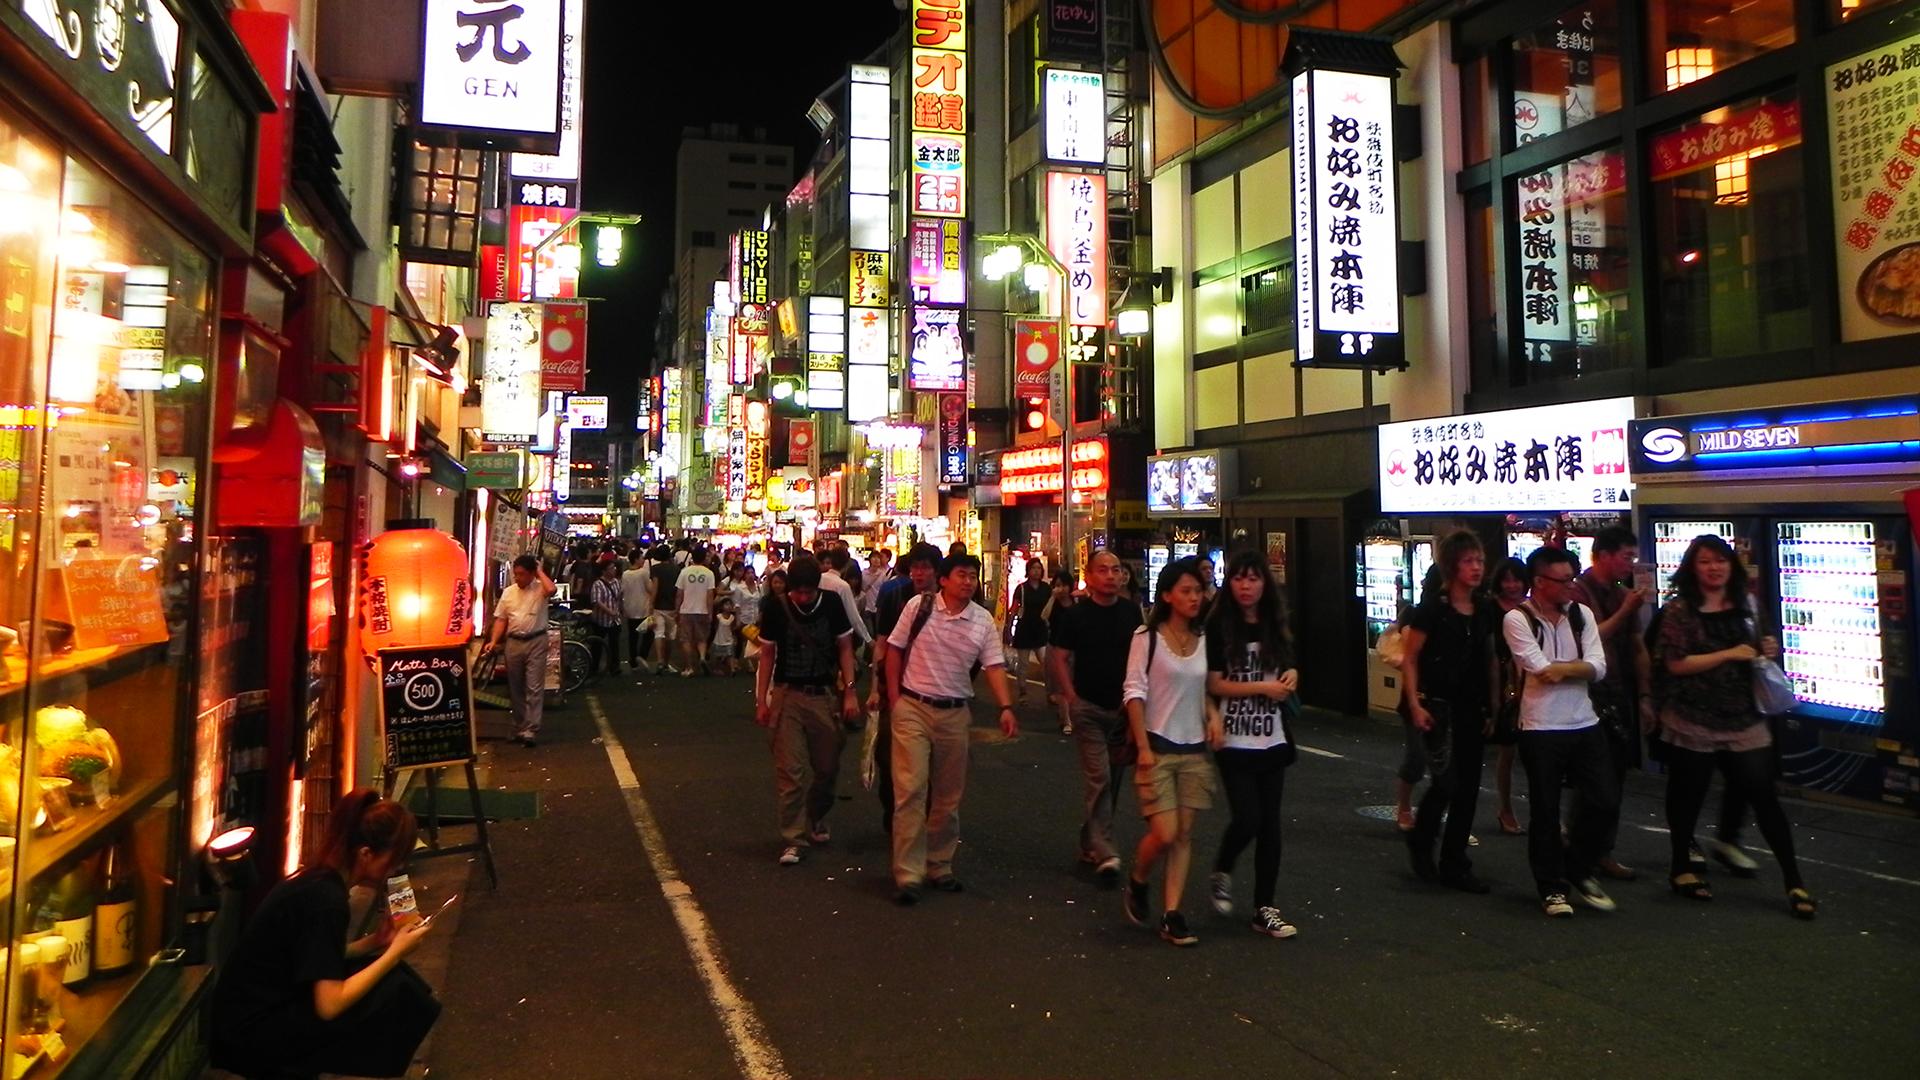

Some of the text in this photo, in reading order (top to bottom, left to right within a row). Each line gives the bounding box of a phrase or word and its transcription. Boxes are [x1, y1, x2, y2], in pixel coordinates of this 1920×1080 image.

[455, 1, 532, 65] 元
[464, 77, 519, 98] GEN
[914, 91, 963, 131] 鑑賞
[918, 146, 960, 163] 金太郎
[521, 183, 567, 206] 焼肉
[919, 174, 958, 194] 2F
[1326, 113, 1365, 315] お好み焼本陣
[866, 253, 884, 277] 麻雀
[1340, 333, 1375, 356] 2F
[1699, 426, 1800, 451] MILD SEVEN
[1413, 435, 1585, 486] お好み焼本陣
[370, 578, 390, 632] 本格焼酎
[411, 684, 435, 699] 500
[1223, 715, 1274, 737] RINGO
